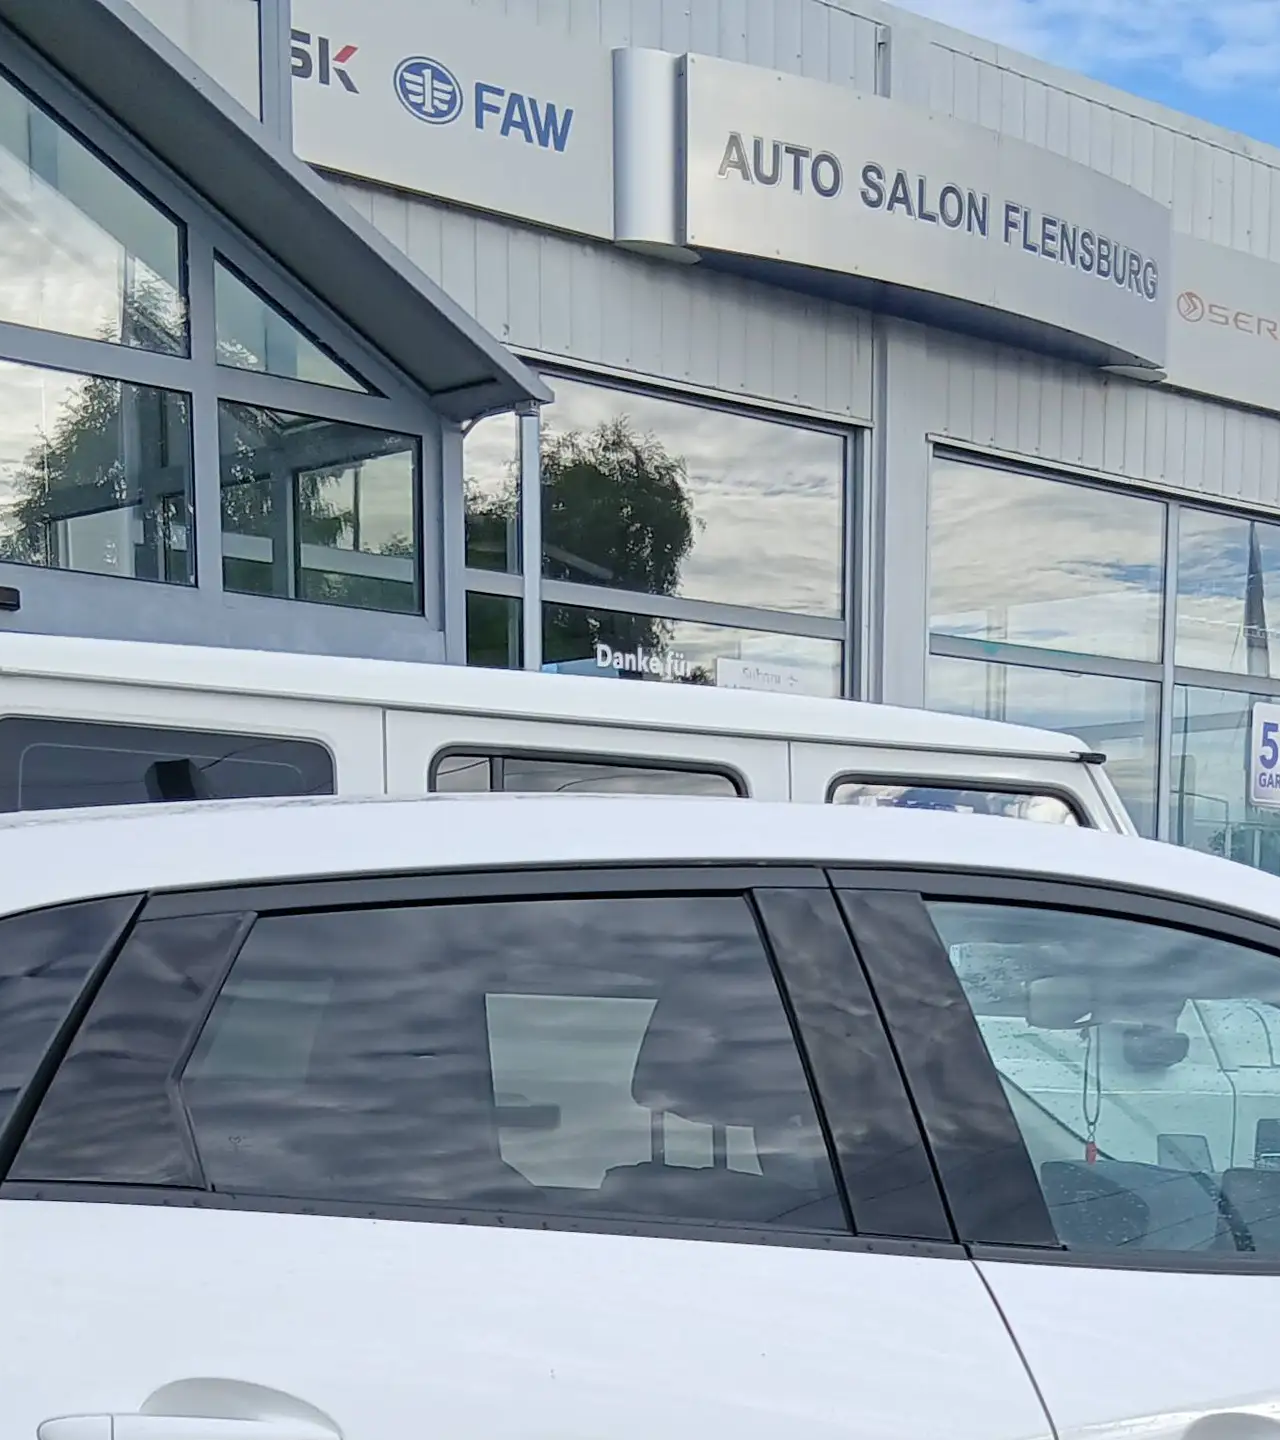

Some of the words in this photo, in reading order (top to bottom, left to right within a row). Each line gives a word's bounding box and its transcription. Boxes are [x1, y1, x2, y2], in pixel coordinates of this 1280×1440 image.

[474, 81, 574, 152] FAW
[718, 131, 842, 199] AUTO
[859, 160, 990, 240] SALON
[1002, 200, 1159, 301] FLENSBURG
[596, 644, 659, 673] Danke
[1259, 721, 1279, 769] 5
